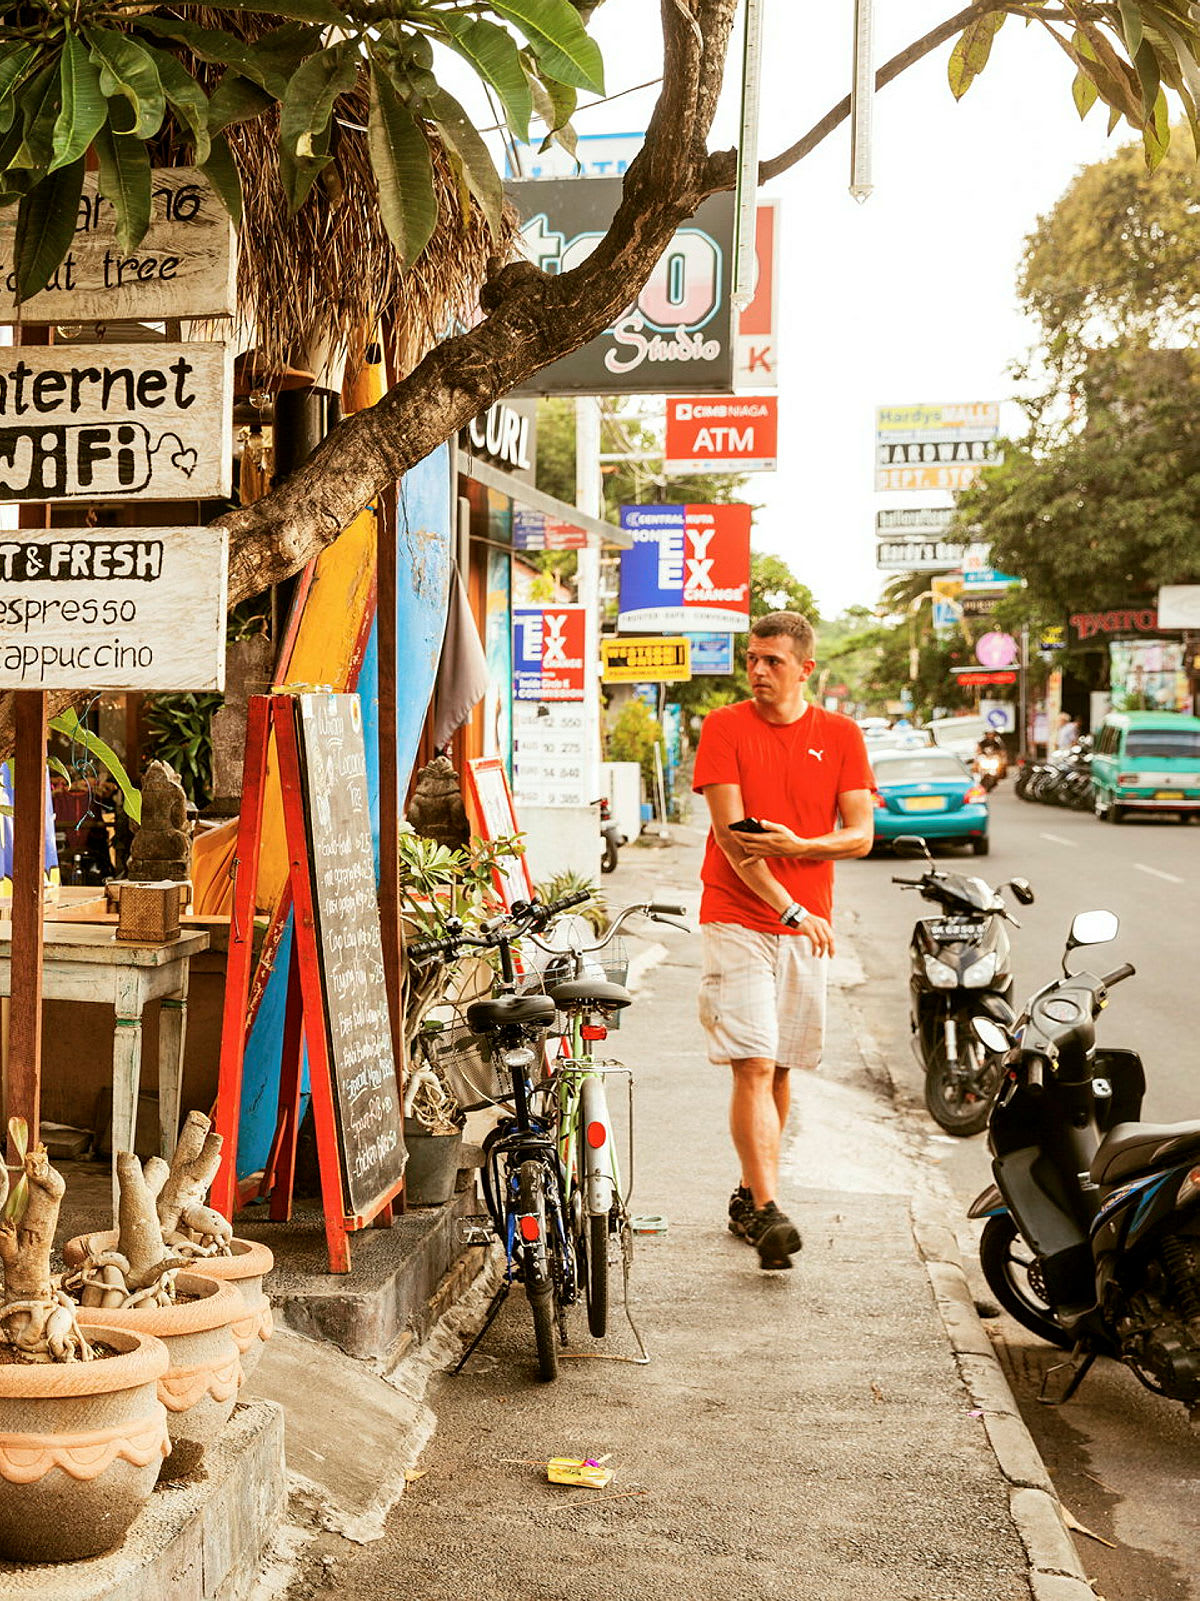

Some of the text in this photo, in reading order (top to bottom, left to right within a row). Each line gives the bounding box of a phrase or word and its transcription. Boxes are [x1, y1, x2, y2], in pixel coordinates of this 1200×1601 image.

[102, 250, 184, 289] tree
[604, 314, 721, 374] Studio
[469, 400, 531, 470] CURL
[692, 427, 754, 453] ATM
